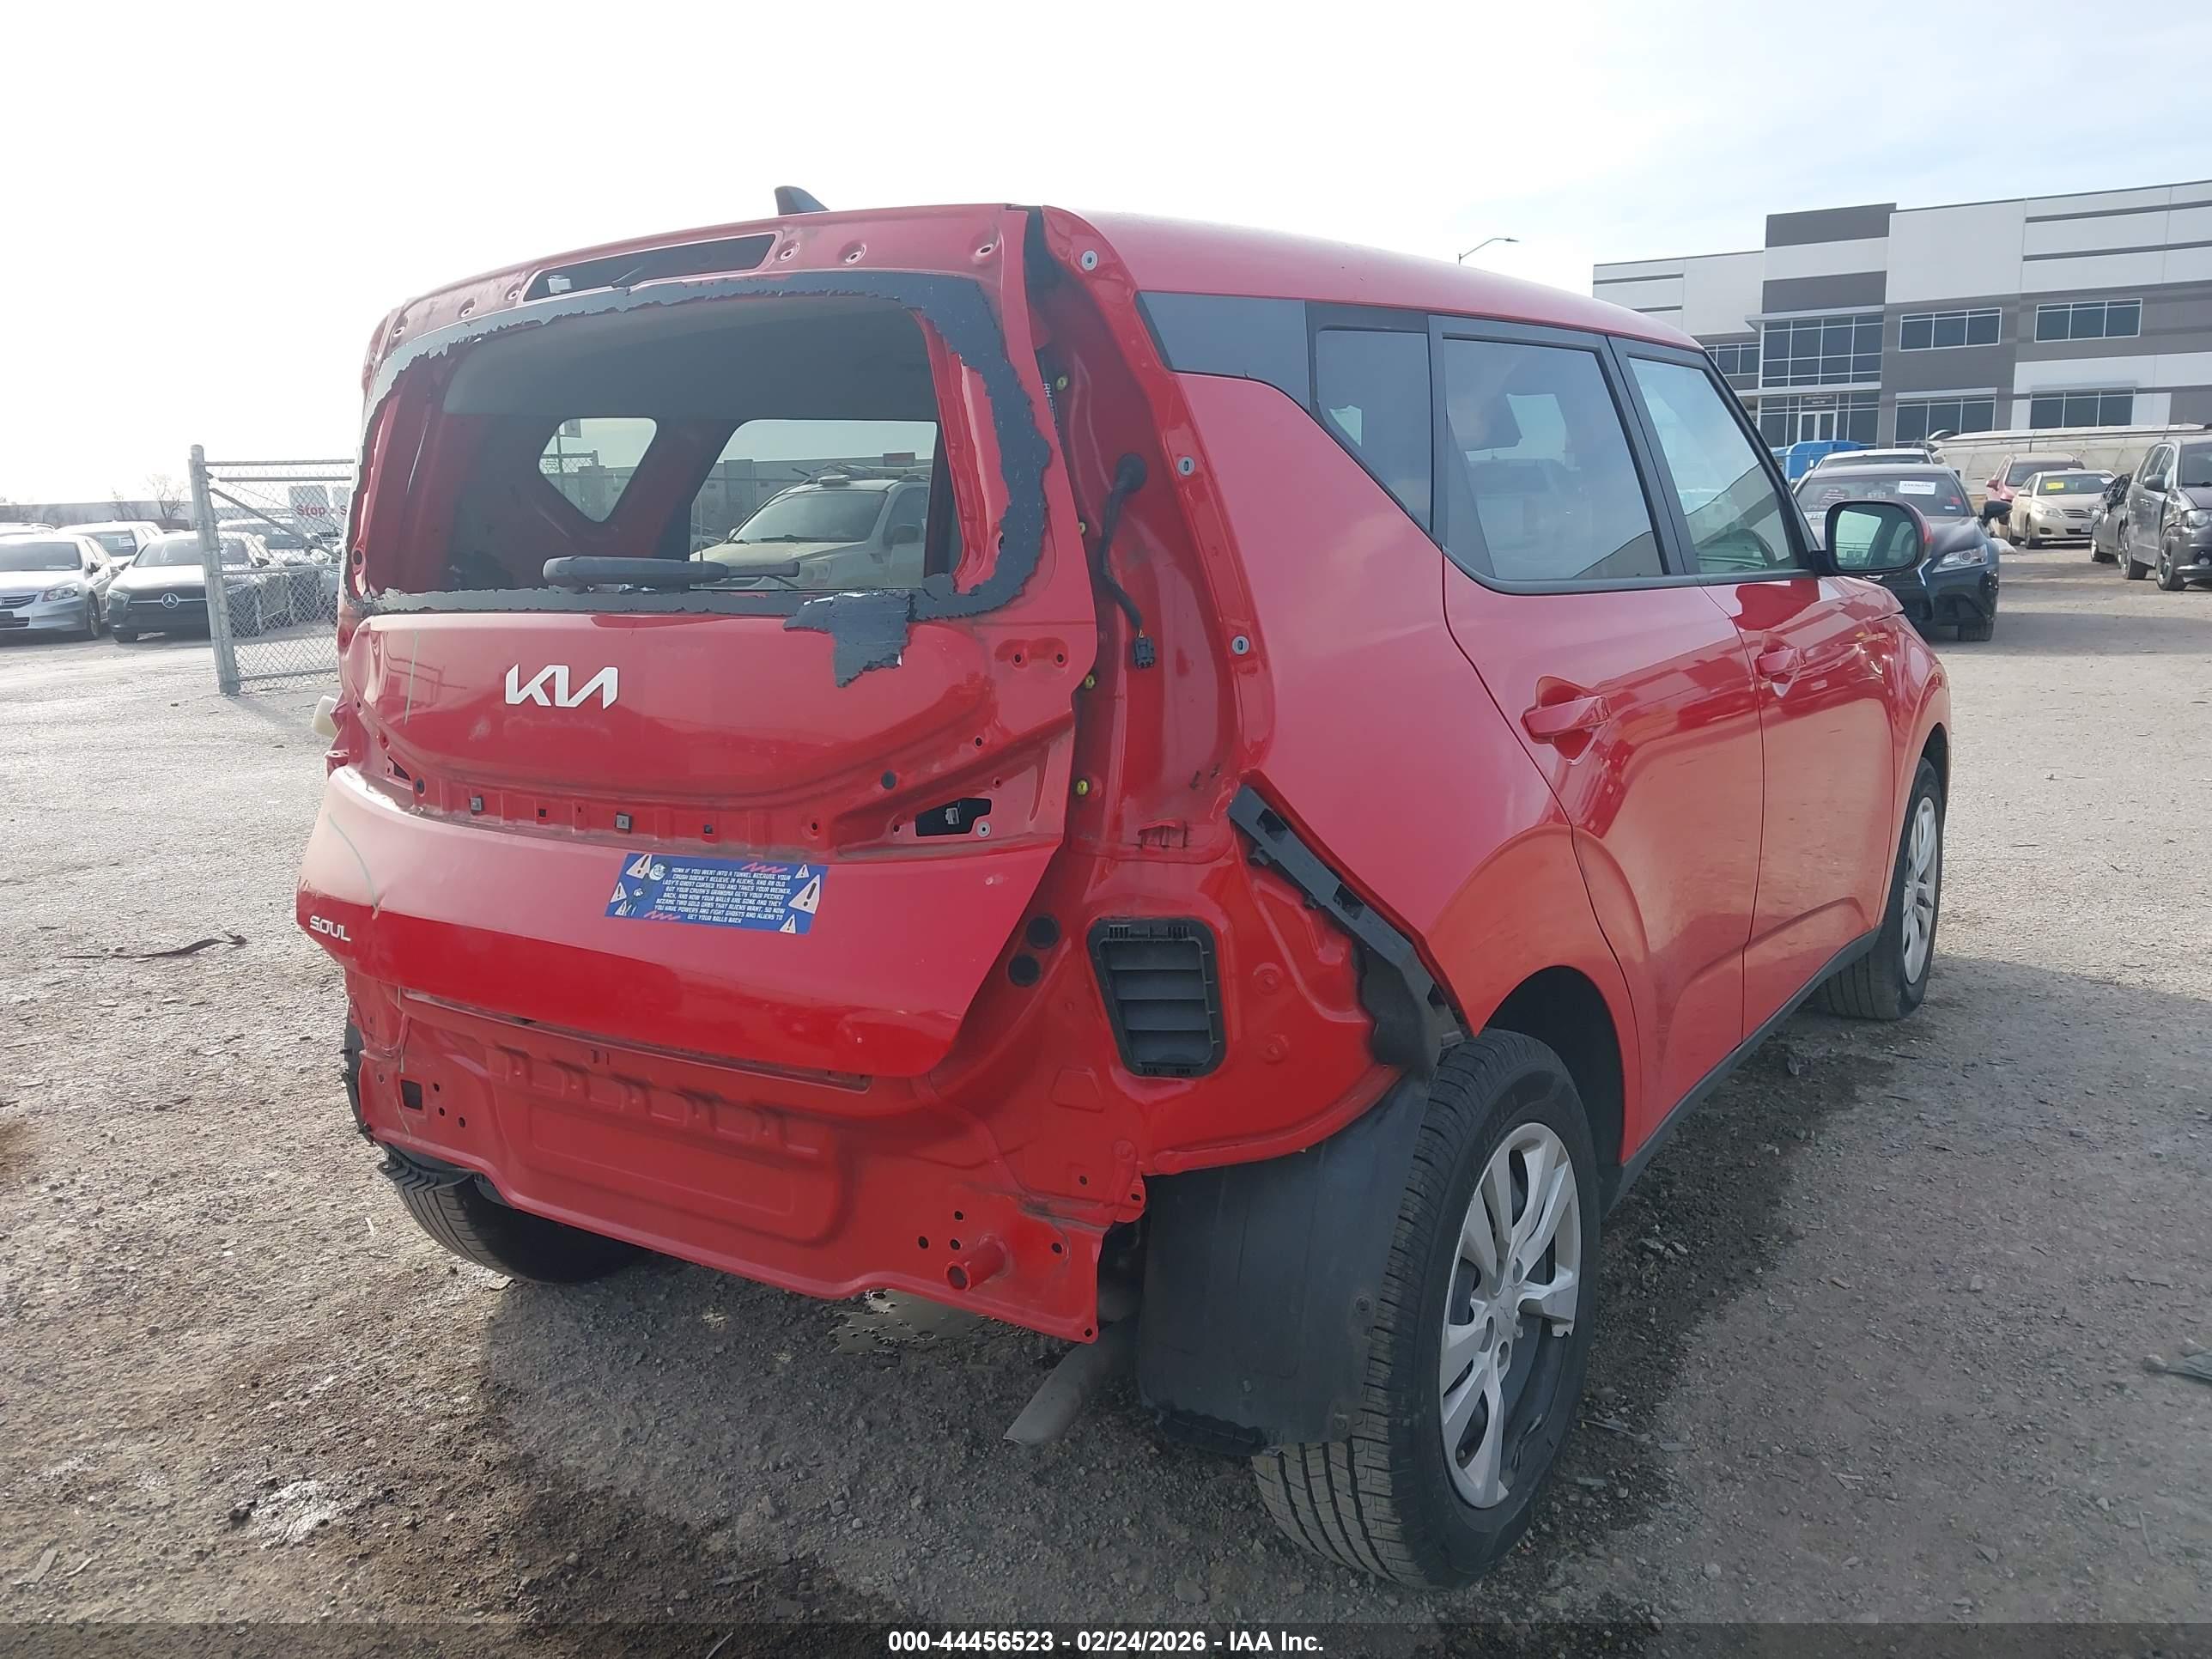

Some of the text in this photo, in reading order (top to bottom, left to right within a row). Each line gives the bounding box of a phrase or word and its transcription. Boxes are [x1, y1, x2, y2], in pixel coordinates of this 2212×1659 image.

[296, 504, 325, 518] Stop
[505, 664, 618, 709] KIA
[309, 915, 350, 941] SOUL
